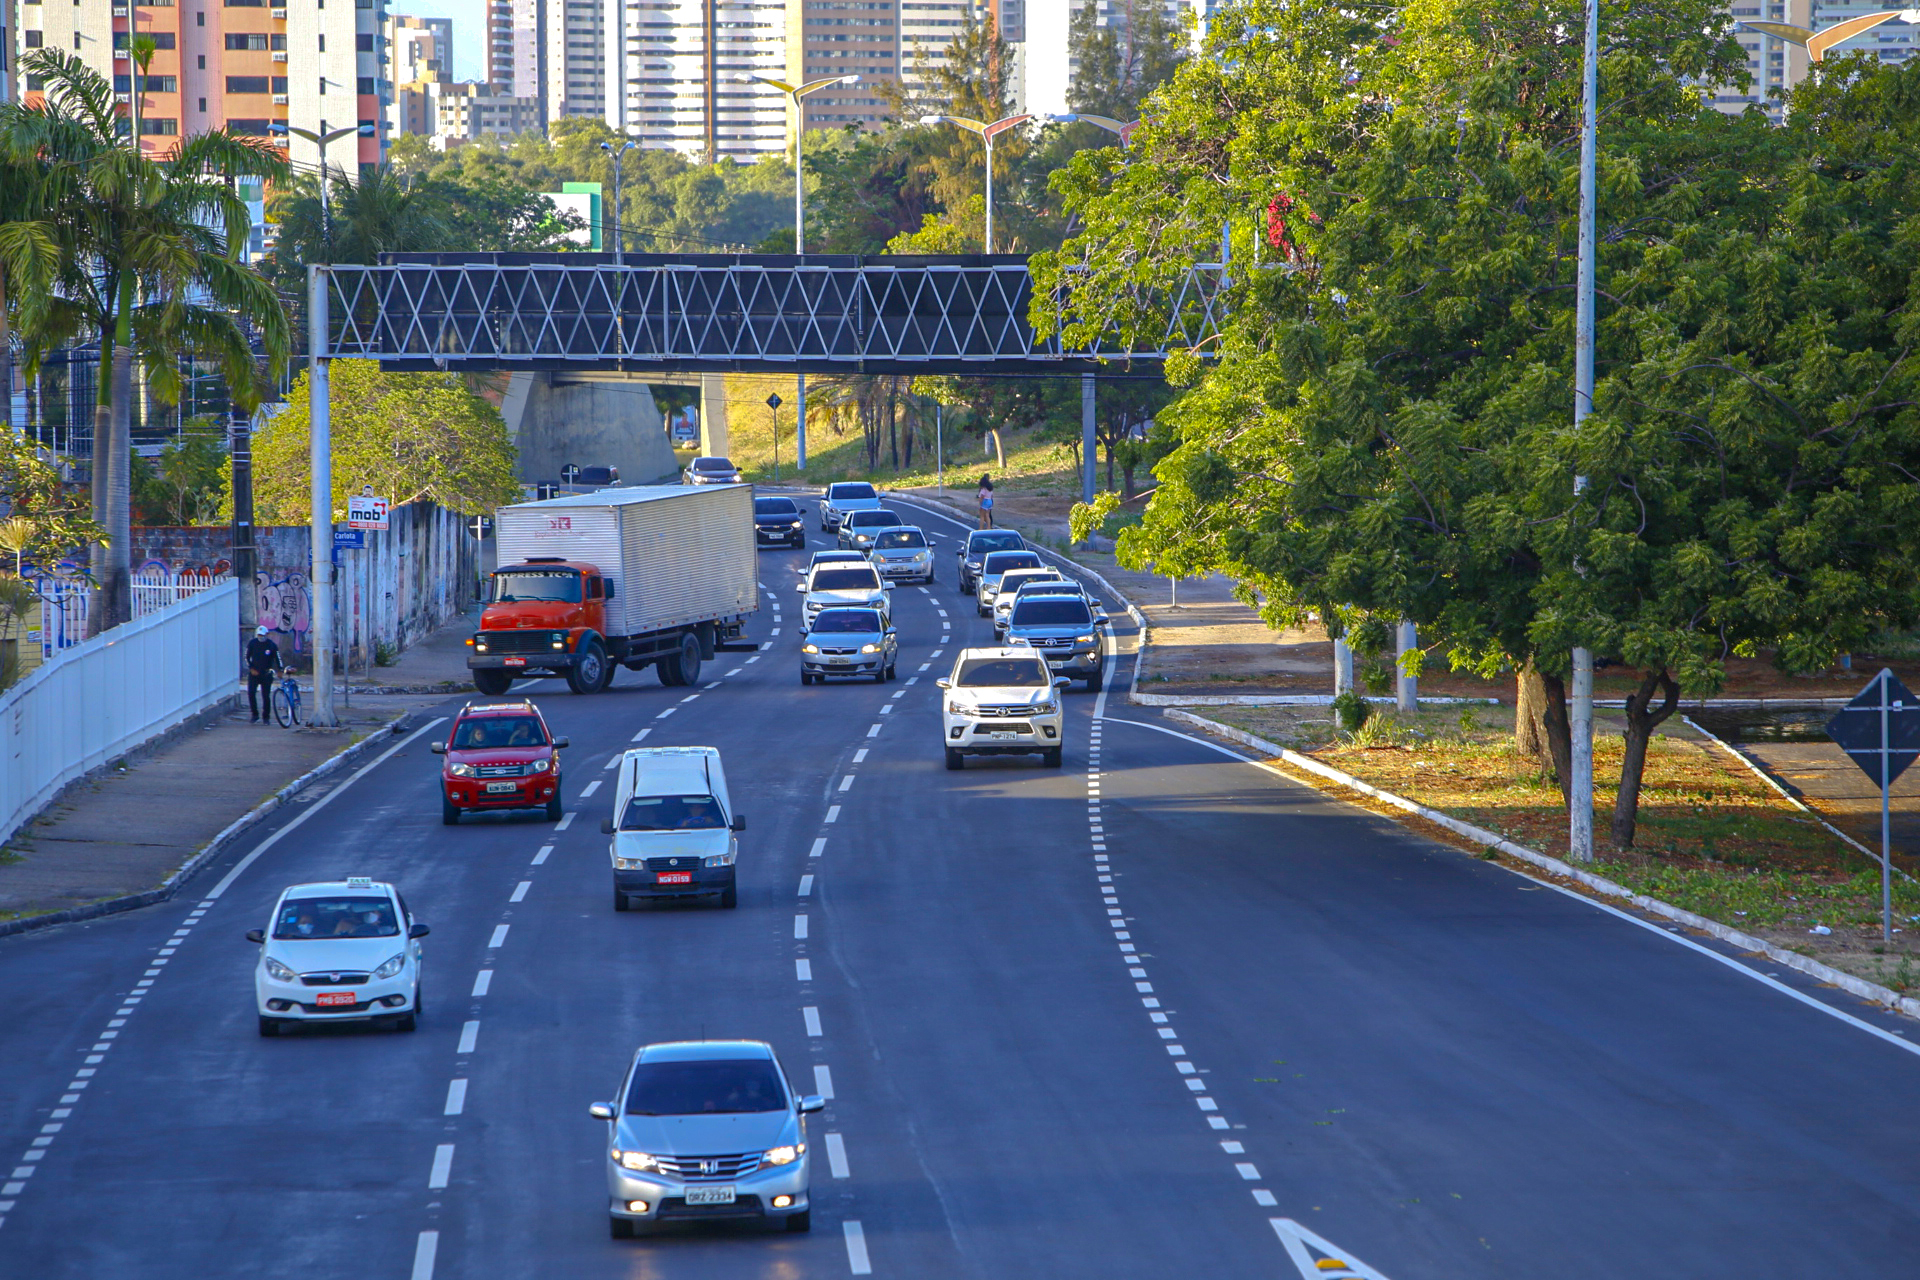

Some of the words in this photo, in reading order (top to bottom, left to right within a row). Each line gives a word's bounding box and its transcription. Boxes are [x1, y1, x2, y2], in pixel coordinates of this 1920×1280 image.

[351, 509, 380, 520] mob
[334, 532, 356, 540] Carlota
[497, 571, 544, 579] EXPRESS
